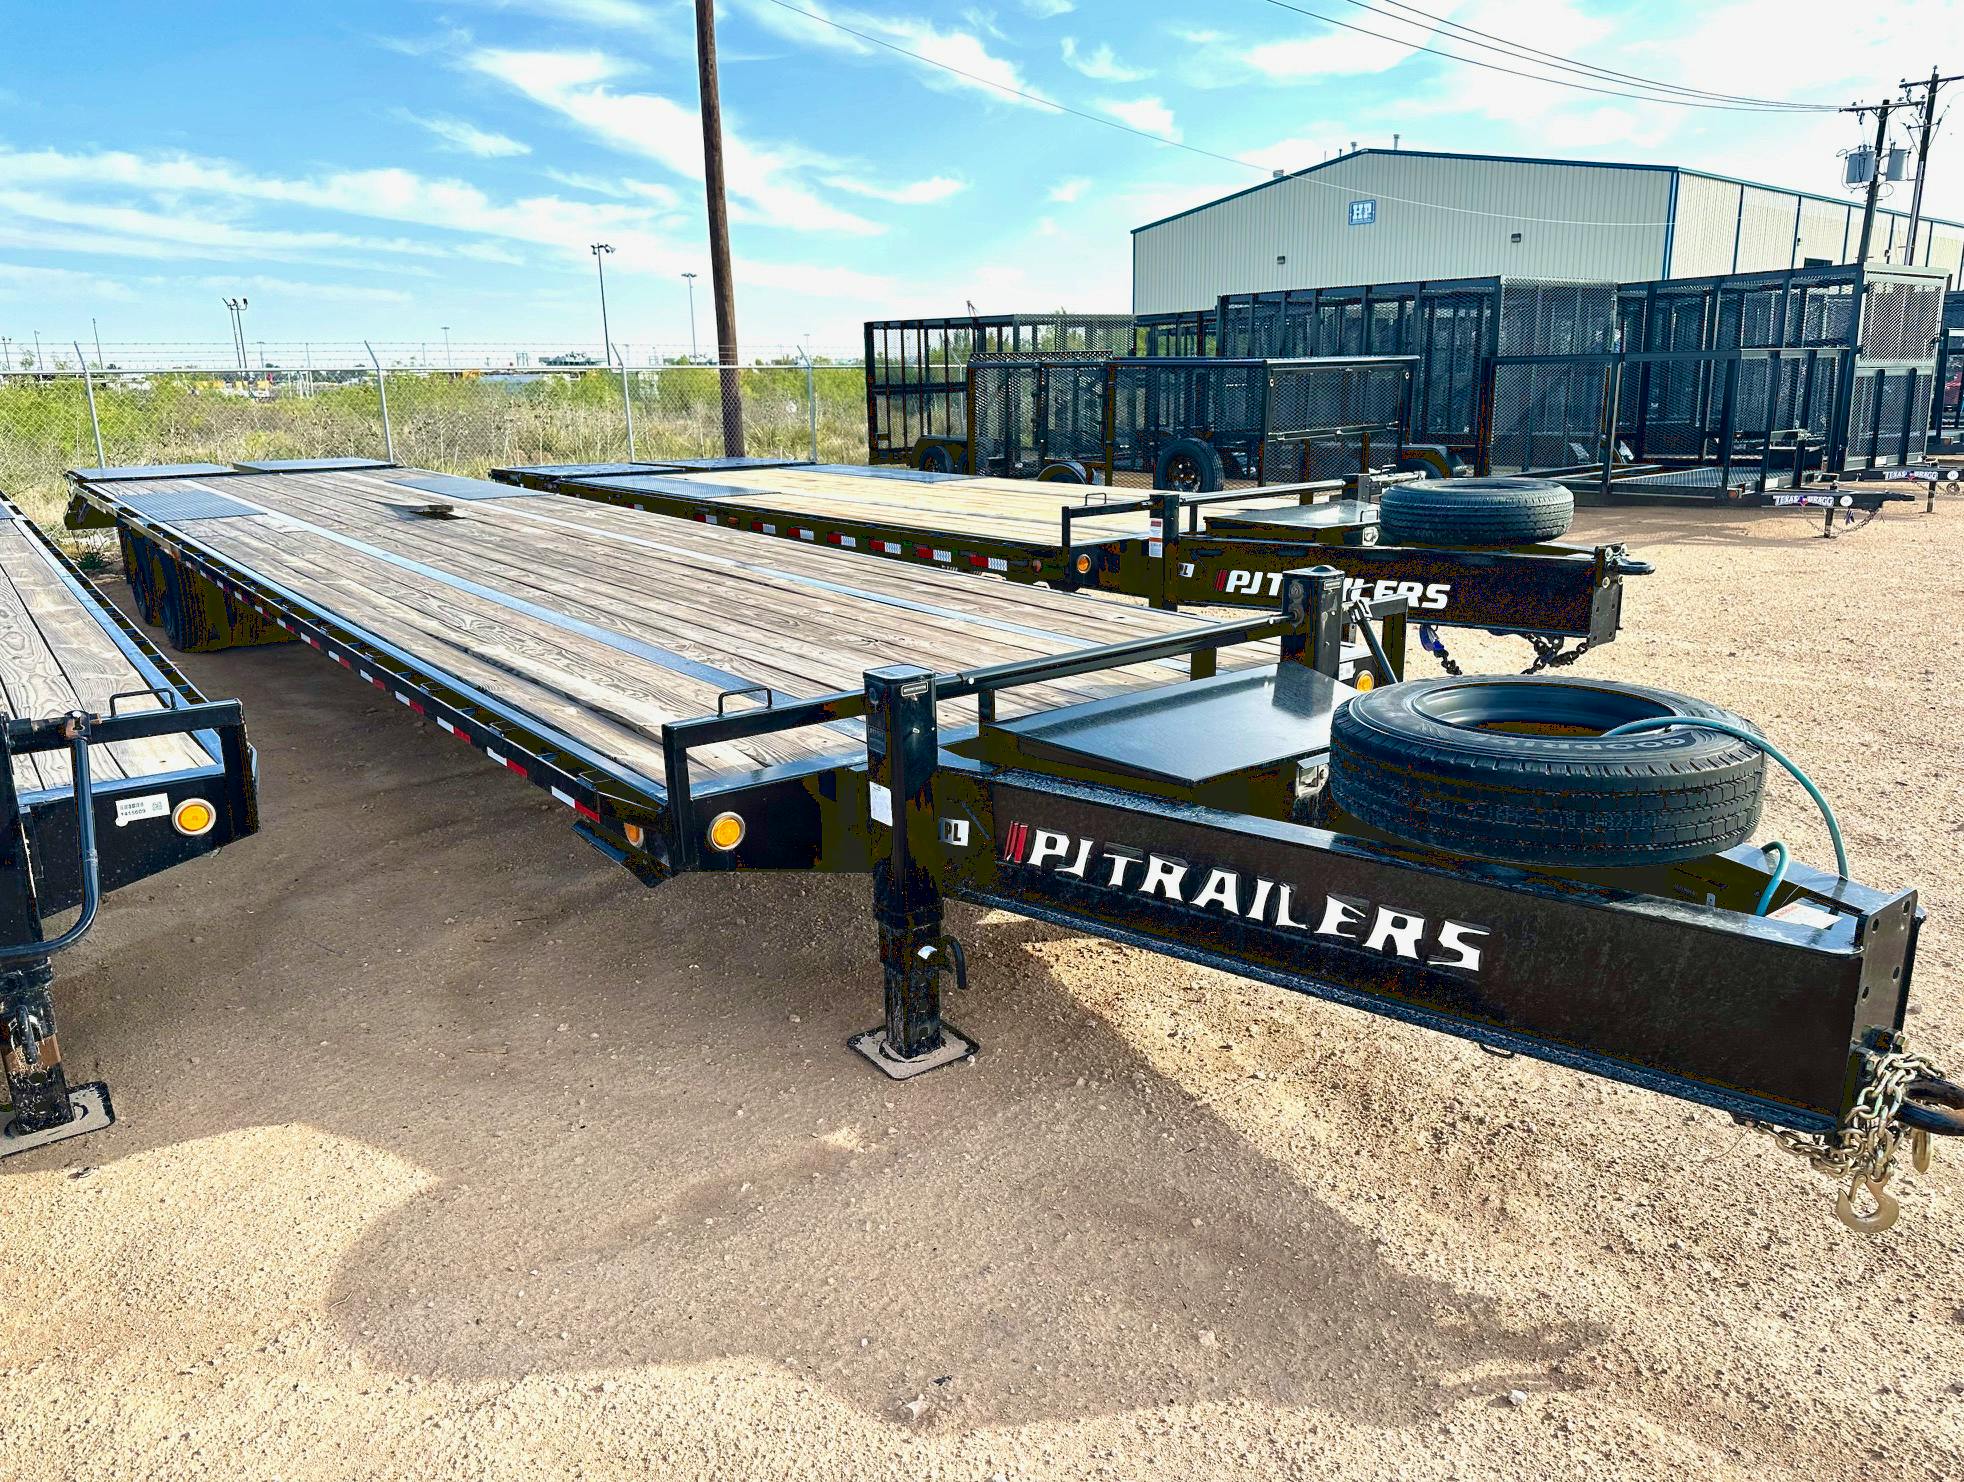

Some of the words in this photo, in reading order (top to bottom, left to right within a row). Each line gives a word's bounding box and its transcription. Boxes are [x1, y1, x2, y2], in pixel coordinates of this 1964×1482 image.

[1352, 202, 1372, 220] HP
[1225, 570, 1263, 595] PJ
[1267, 571, 1451, 610] TILERS
[1027, 829, 1094, 878] PJ
[1102, 849, 1490, 972] TRAILERS
